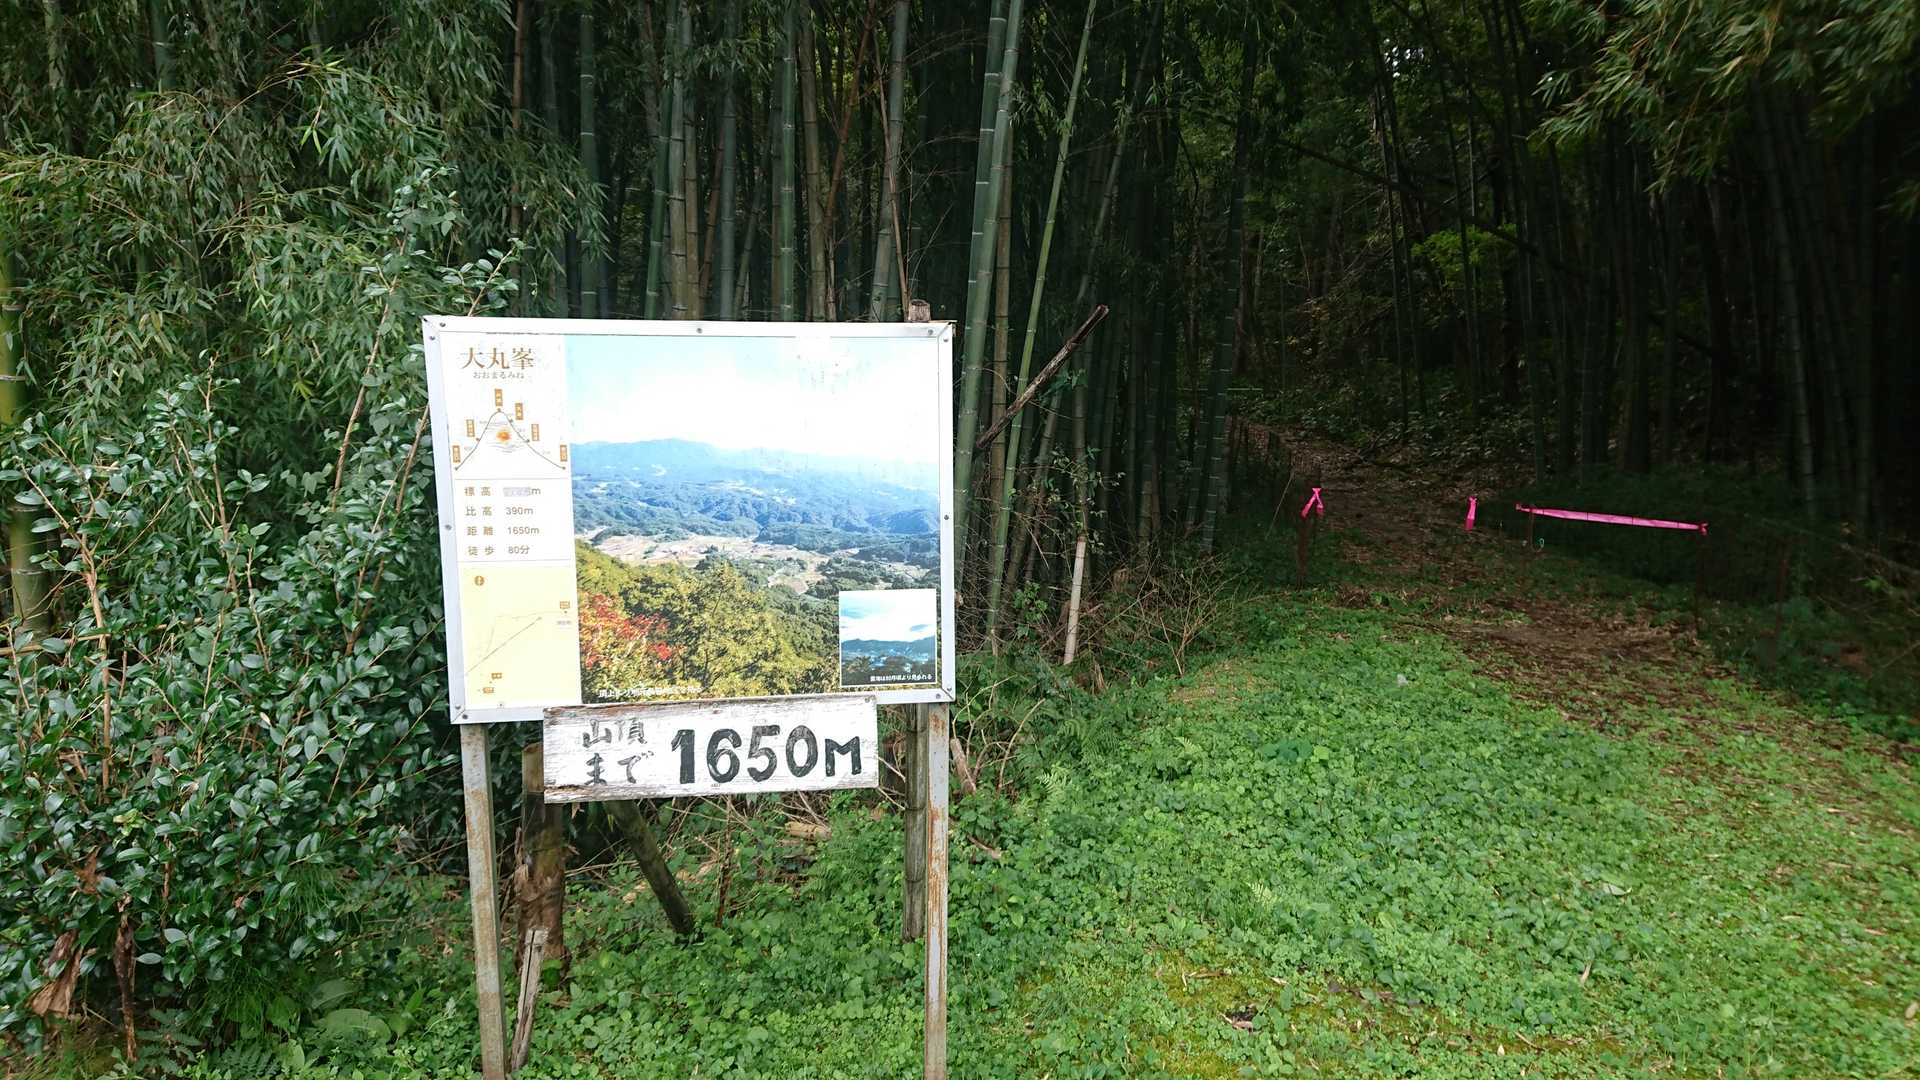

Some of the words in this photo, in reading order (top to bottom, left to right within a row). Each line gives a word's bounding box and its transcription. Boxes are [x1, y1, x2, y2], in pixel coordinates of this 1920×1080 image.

[460, 347, 536, 370] 大丸峯
[473, 371, 525, 380] おおまるみね
[505, 506, 534, 516] 390m
[507, 526, 540, 535] 1650m
[508, 545, 530, 555] 80分
[582, 717, 648, 749] 山頂
[584, 750, 655, 786] まで
